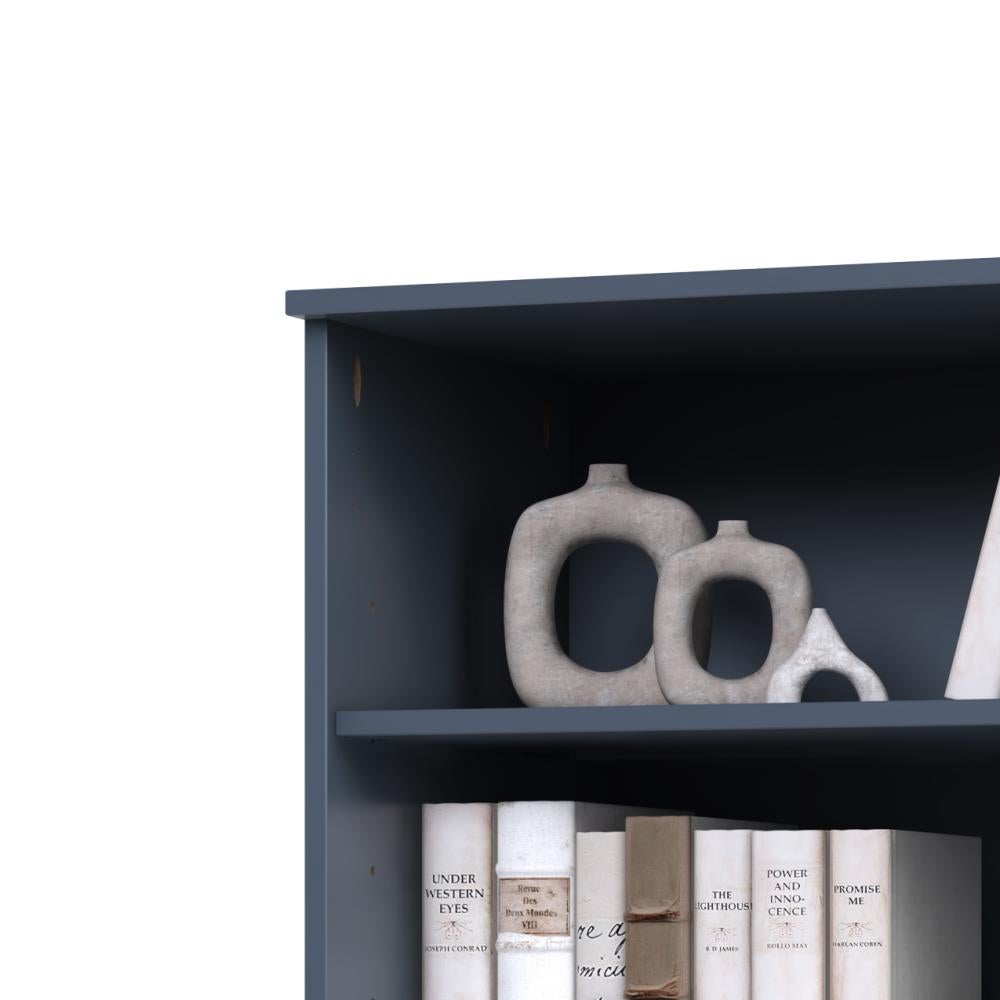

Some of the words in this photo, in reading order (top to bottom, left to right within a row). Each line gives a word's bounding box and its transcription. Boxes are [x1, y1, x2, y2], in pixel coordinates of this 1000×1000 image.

[767, 869, 808, 879] POWER
[432, 874, 476, 884] UNDER
[517, 884, 541, 893] Revue
[774, 882, 801, 891] AND
[833, 884, 881, 894] PROMISE
[425, 888, 485, 899] WESTERN
[712, 891, 733, 899] THE
[522, 896, 538, 905] Des
[770, 894, 805, 904] INNO-
[848, 897, 865, 906] ME
[439, 903, 469, 914] EYES
[505, 908, 524, 917] Deux
[768, 907, 808, 916] CENCE
[451, 945, 488, 953] CONRAD
